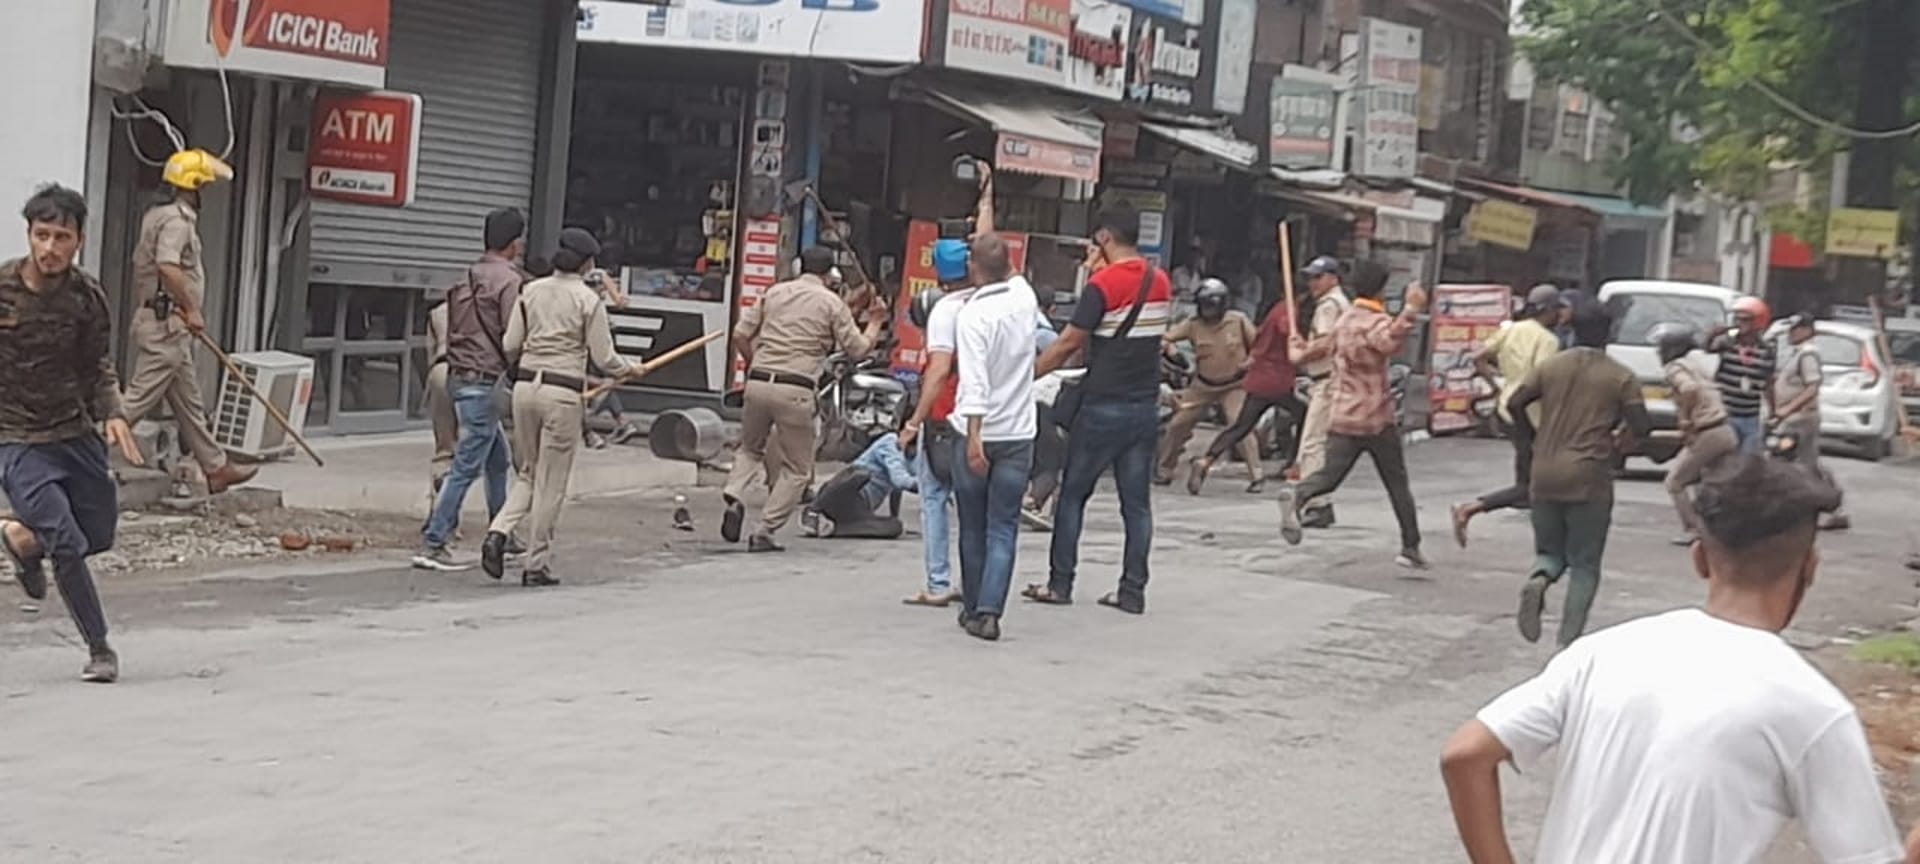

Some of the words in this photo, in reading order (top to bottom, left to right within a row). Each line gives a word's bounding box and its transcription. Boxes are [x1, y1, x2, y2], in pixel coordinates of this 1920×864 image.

[267, 11, 324, 49] ICICI
[325, 21, 379, 59] Bank
[321, 107, 395, 144] ATM
